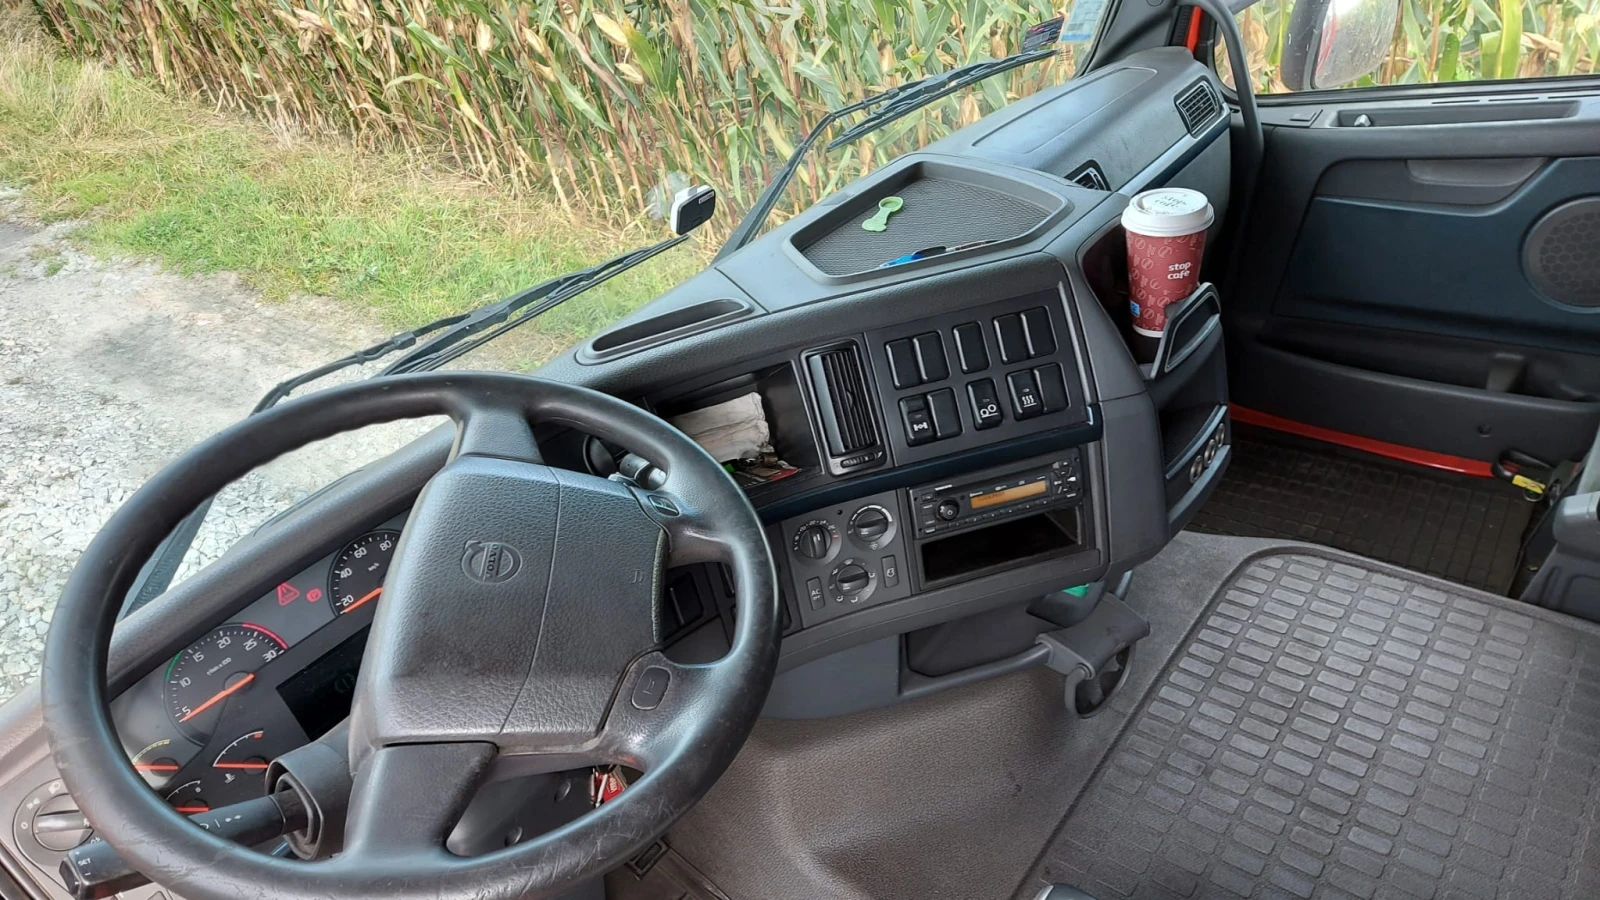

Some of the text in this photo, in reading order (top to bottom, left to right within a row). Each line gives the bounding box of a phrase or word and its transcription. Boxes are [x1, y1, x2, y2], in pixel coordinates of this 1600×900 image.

[1168, 262, 1191, 271] stop
[1167, 270, 1190, 280] cafe
[379, 539, 392, 551] 80
[353, 547, 367, 559] 60
[485, 543, 499, 578] VOLVO
[340, 567, 353, 579] 40
[811, 588, 821, 596] AC
[341, 594, 354, 607] 20
[216, 636, 231, 649] 20
[242, 638, 258, 651] 25
[192, 651, 205, 663] 15
[262, 649, 277, 663] 30
[179, 676, 191, 688] 10
[181, 705, 191, 717] 5
[77, 857, 91, 867] SET
